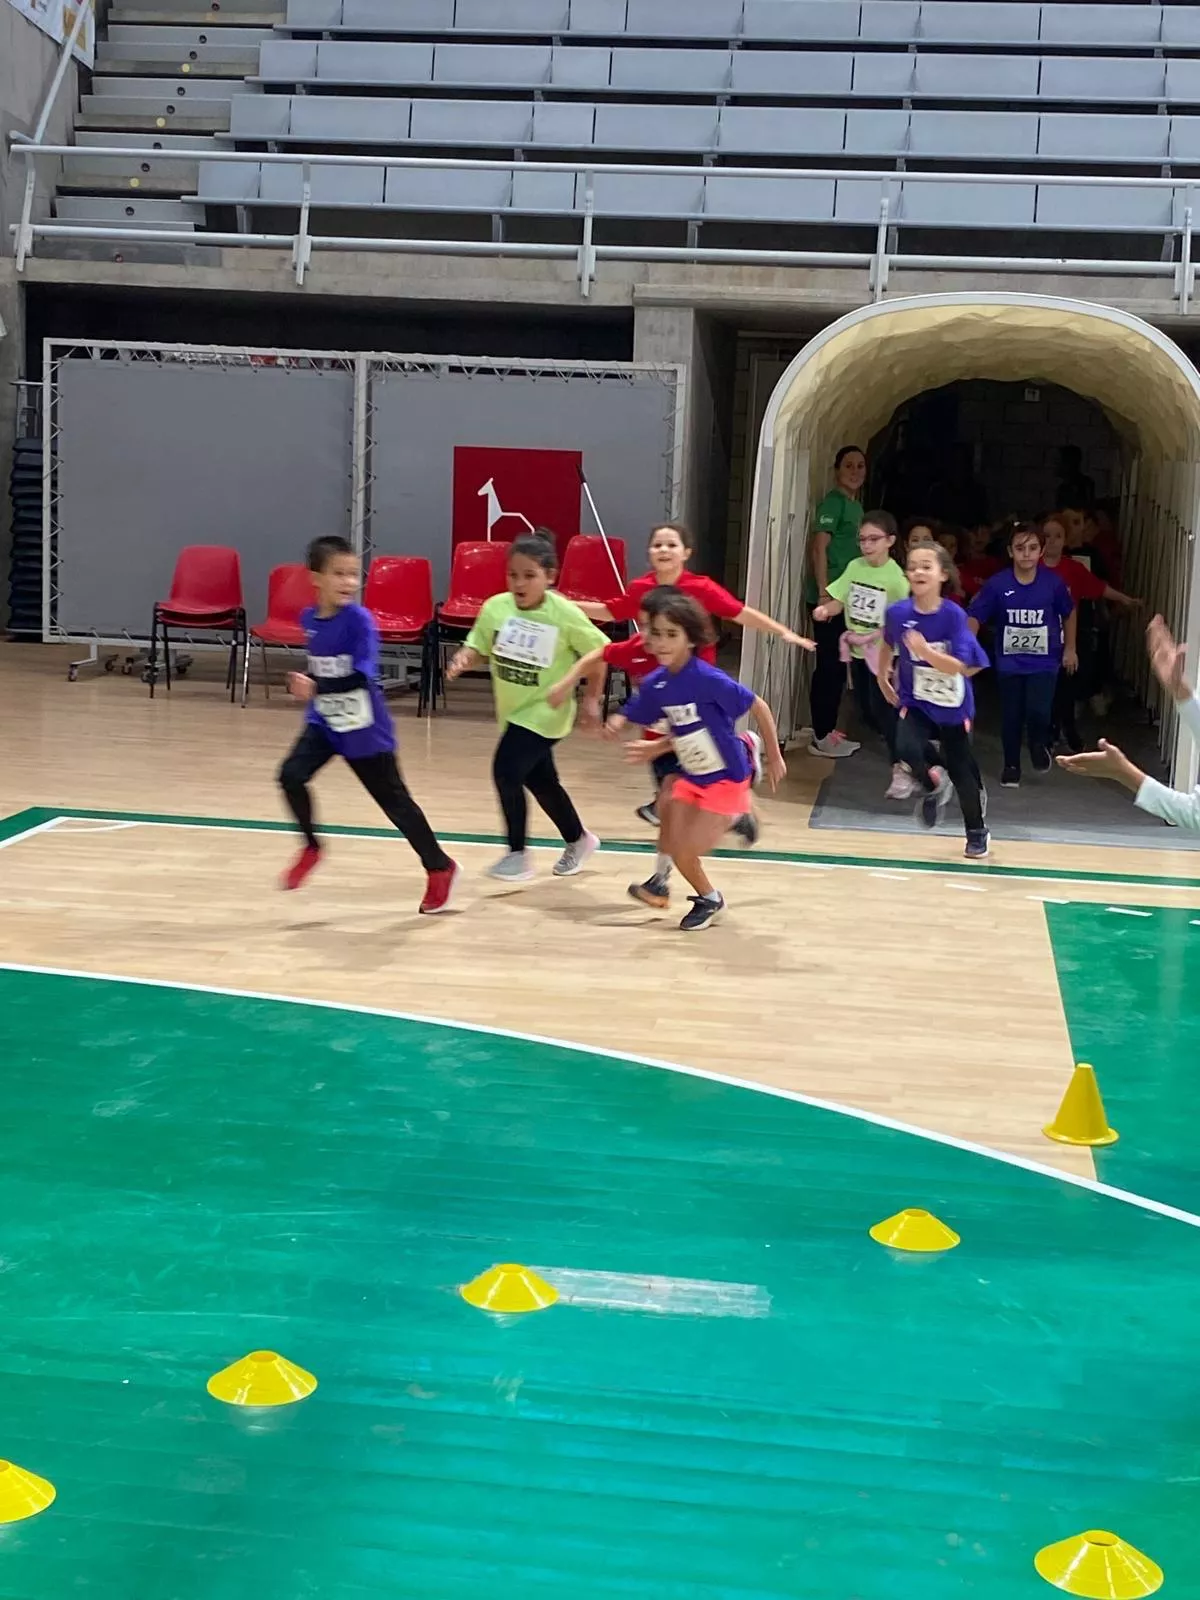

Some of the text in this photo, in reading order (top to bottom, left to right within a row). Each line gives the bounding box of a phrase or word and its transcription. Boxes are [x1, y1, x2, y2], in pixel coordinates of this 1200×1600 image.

[851, 594, 877, 612] 214
[1006, 608, 1044, 625] TIERZ
[1011, 635, 1041, 648] 227
